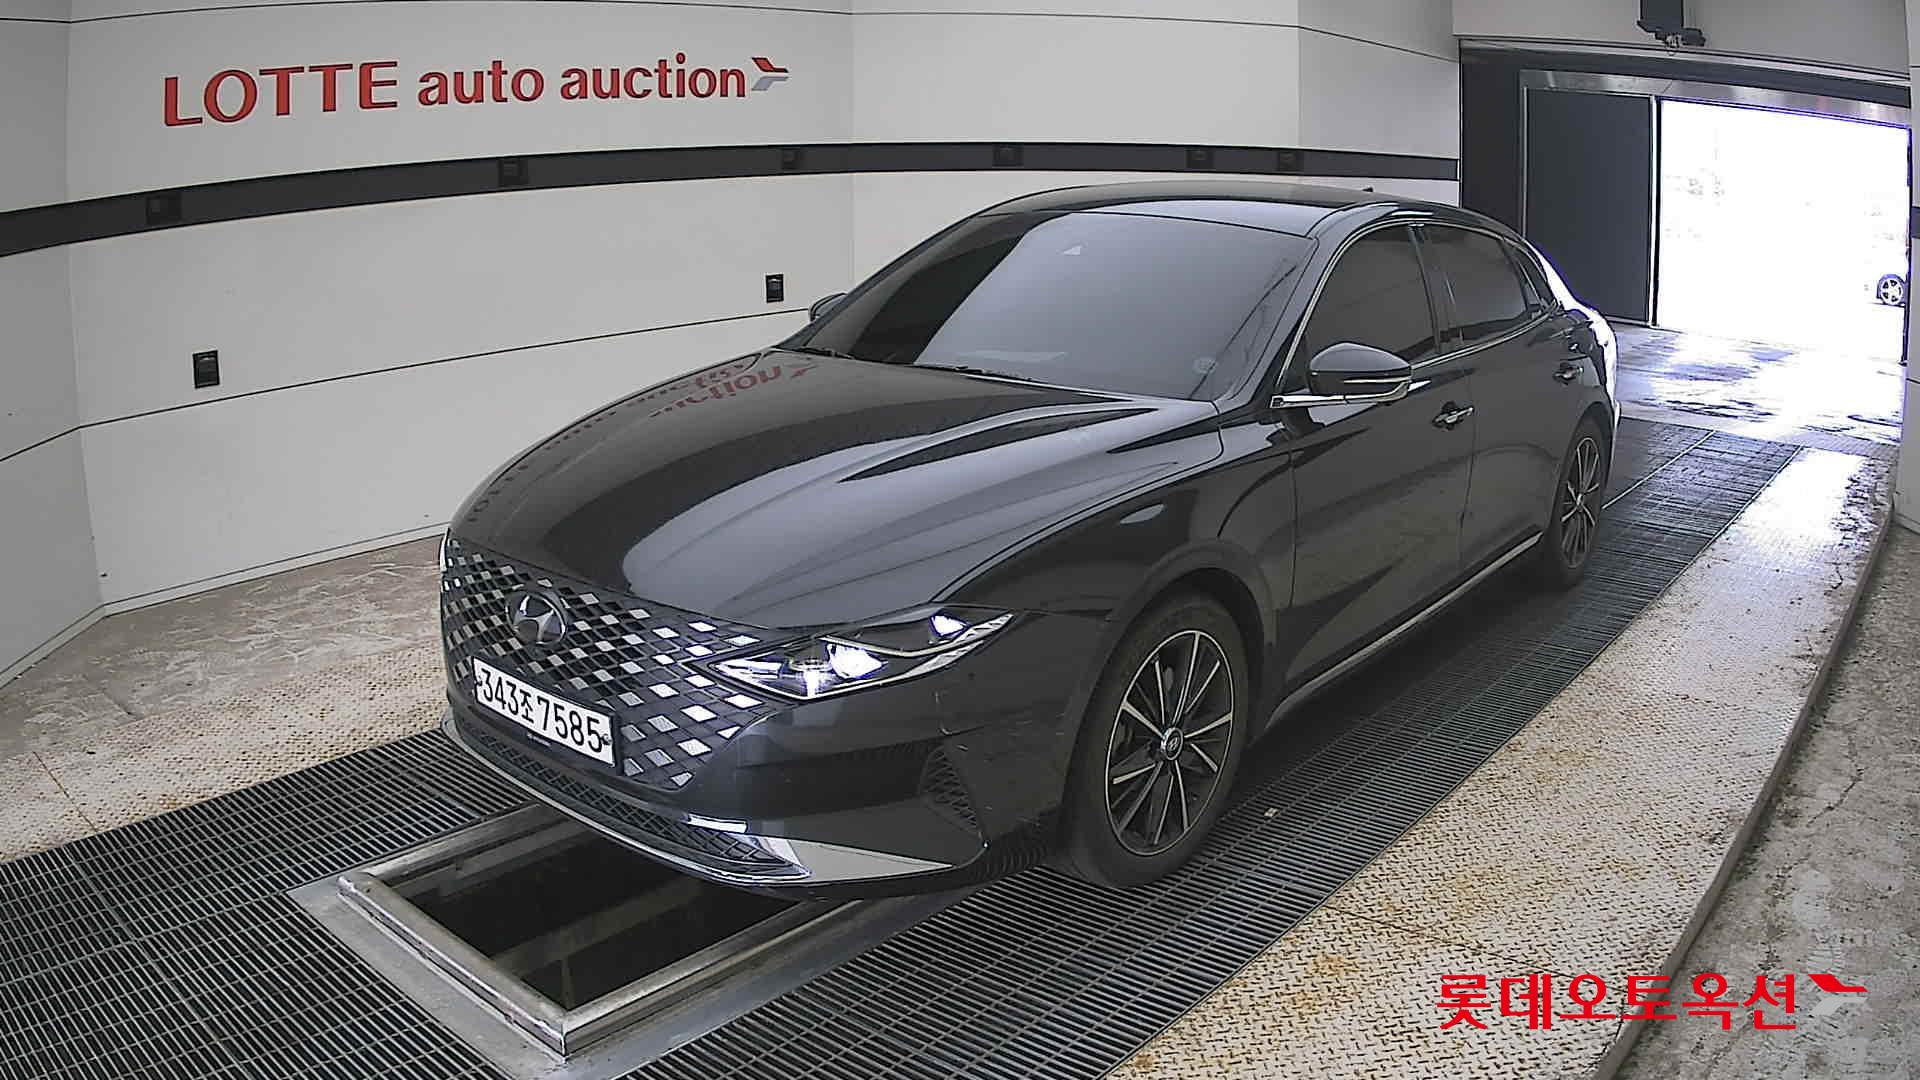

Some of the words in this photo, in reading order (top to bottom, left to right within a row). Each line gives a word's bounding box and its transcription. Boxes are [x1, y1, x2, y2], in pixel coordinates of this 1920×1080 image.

[164, 62, 398, 127] LOTTE
[418, 61, 545, 106] auto
[560, 53, 747, 100] auction
